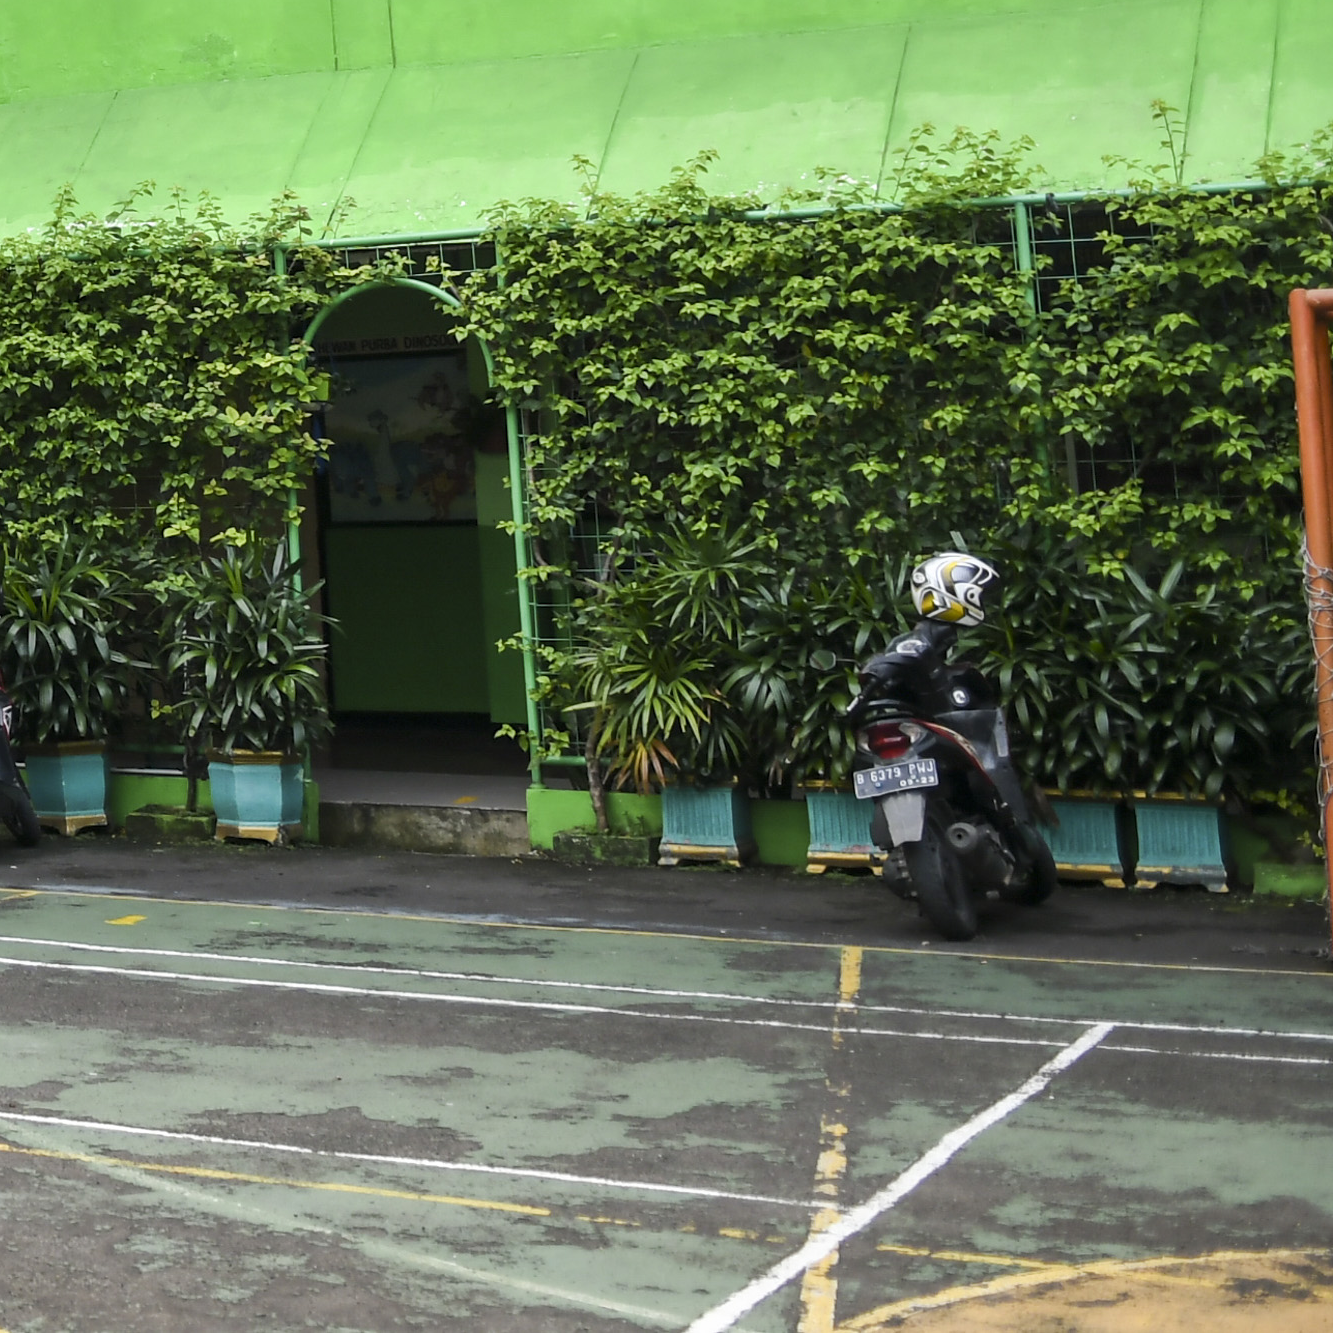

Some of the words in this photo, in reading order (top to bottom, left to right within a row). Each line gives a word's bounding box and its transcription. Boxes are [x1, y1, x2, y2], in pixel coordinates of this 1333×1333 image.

[361, 337, 398, 352] PURBA
[856, 773, 865, 785] B
[870, 766, 901, 782] 6379
[908, 760, 933, 775] PWJ
